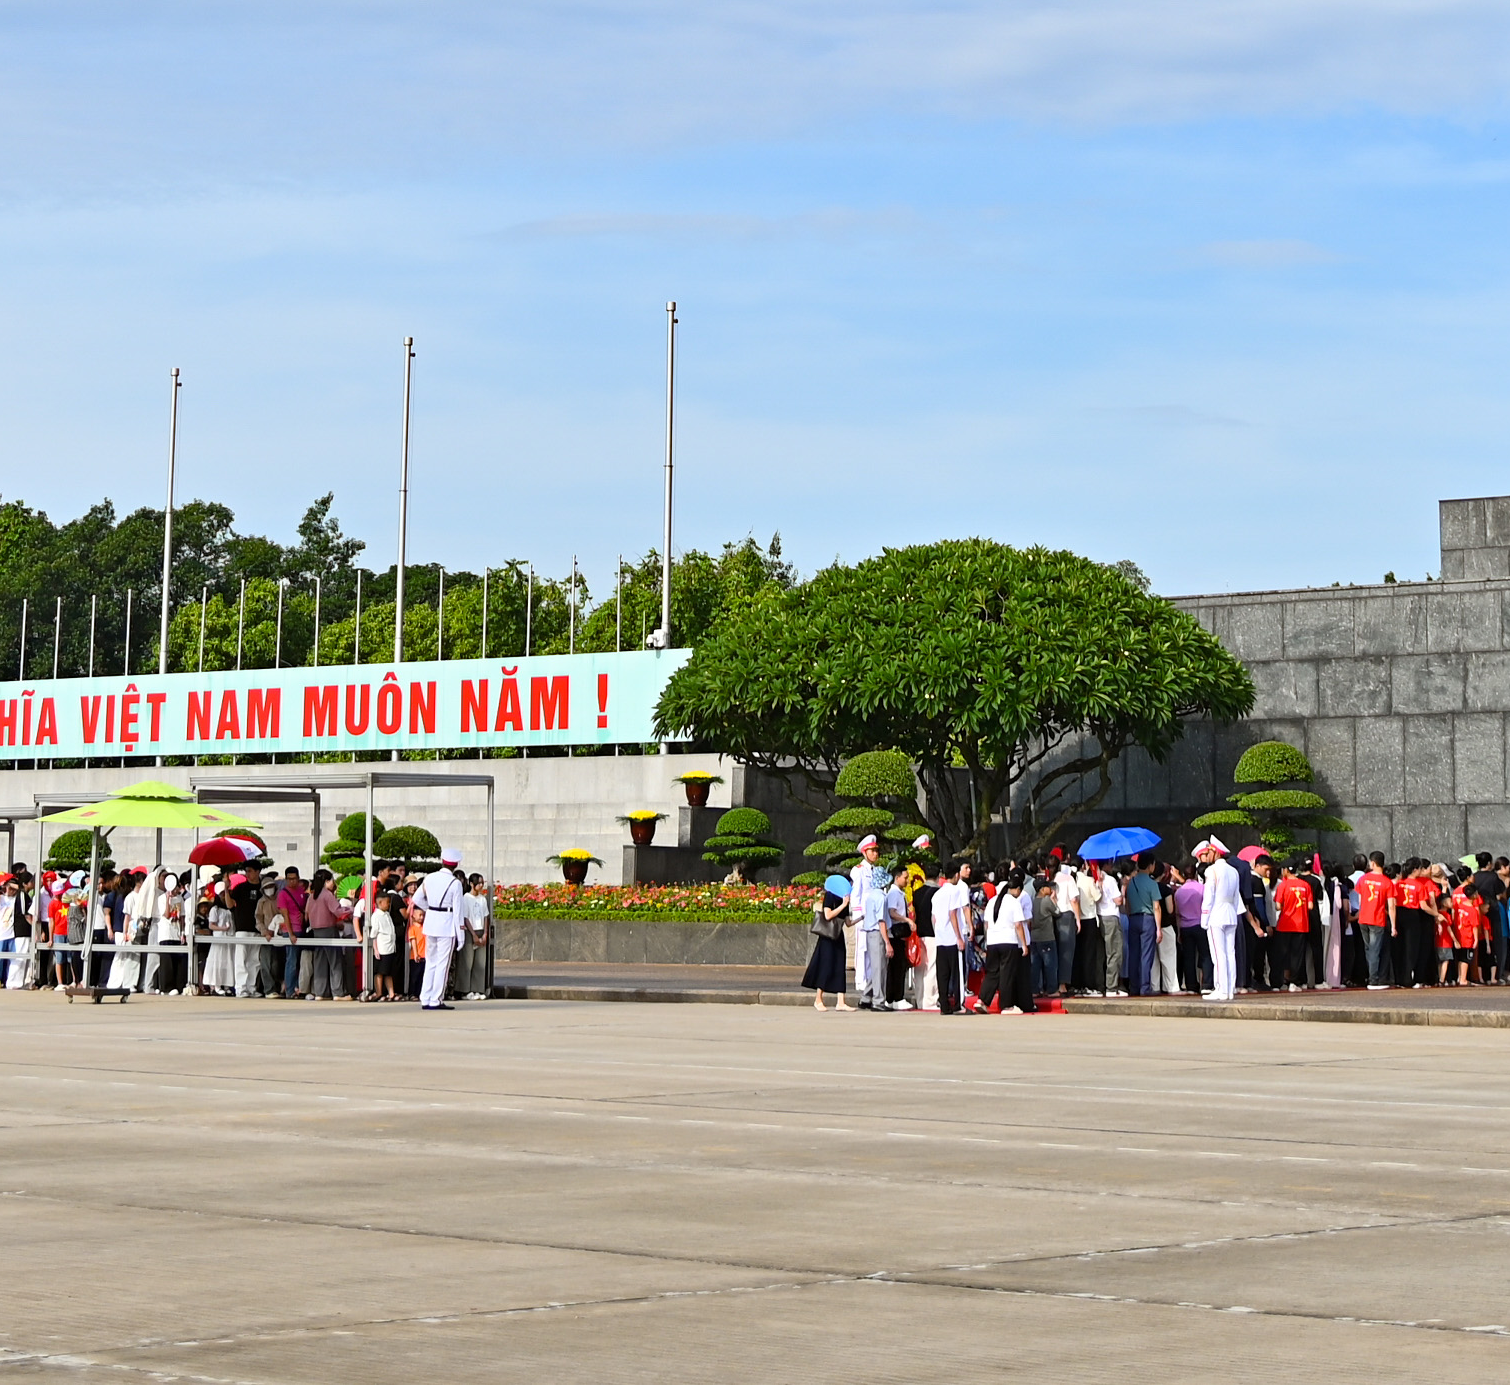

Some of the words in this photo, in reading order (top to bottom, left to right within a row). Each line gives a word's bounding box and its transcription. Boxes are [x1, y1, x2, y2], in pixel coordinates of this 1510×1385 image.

[80, 683, 167, 752] VIỆT
[187, 687, 282, 741] NAM
[302, 671, 437, 738] MUÔN
[460, 665, 570, 733] NĂM
